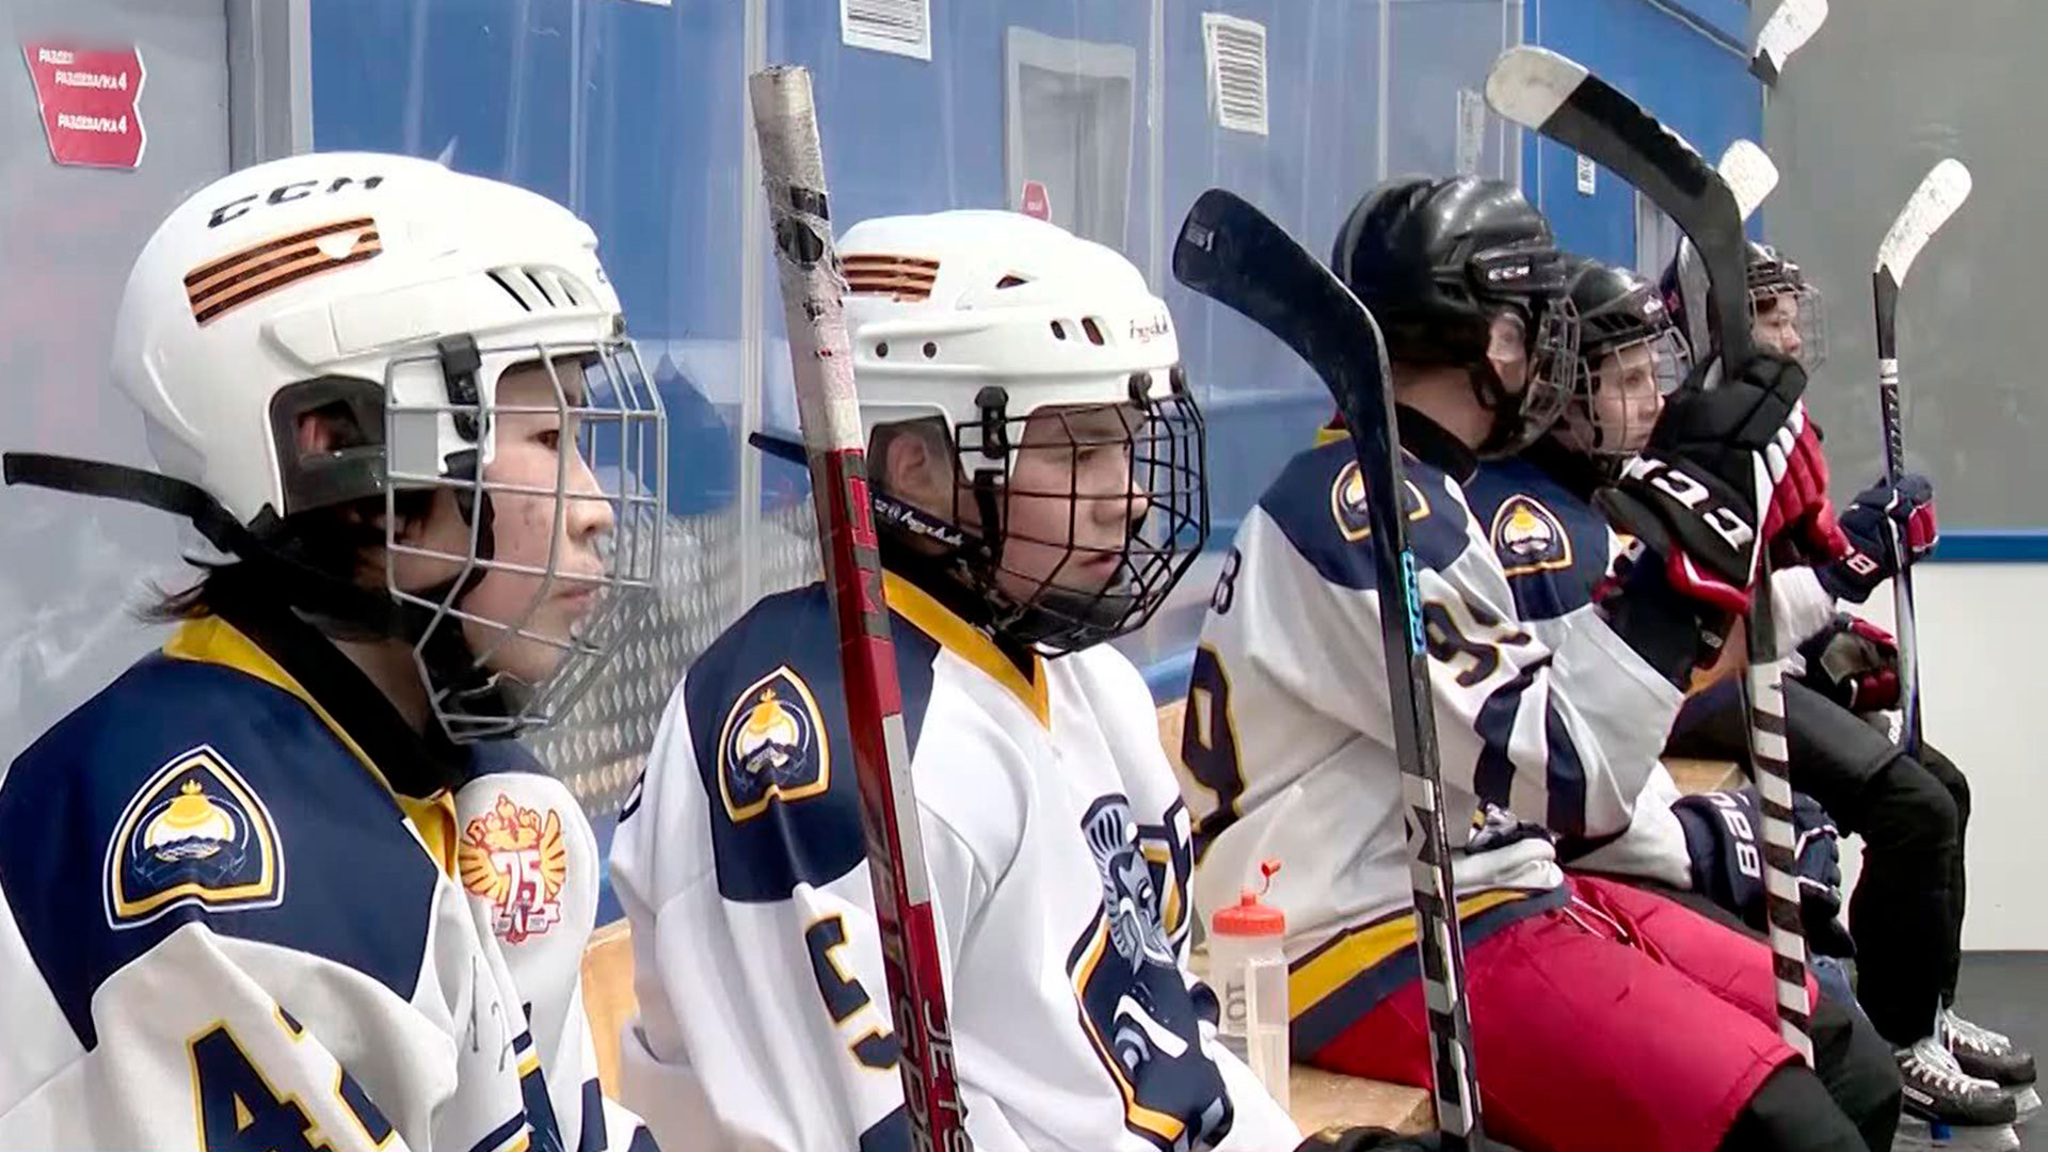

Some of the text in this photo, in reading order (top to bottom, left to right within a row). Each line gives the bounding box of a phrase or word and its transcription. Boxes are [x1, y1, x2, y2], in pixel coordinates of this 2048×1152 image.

[118, 71, 127, 91] 4
[118, 115, 127, 134] 4
[207, 175, 385, 229] CCM
[489, 850, 547, 915] 75
